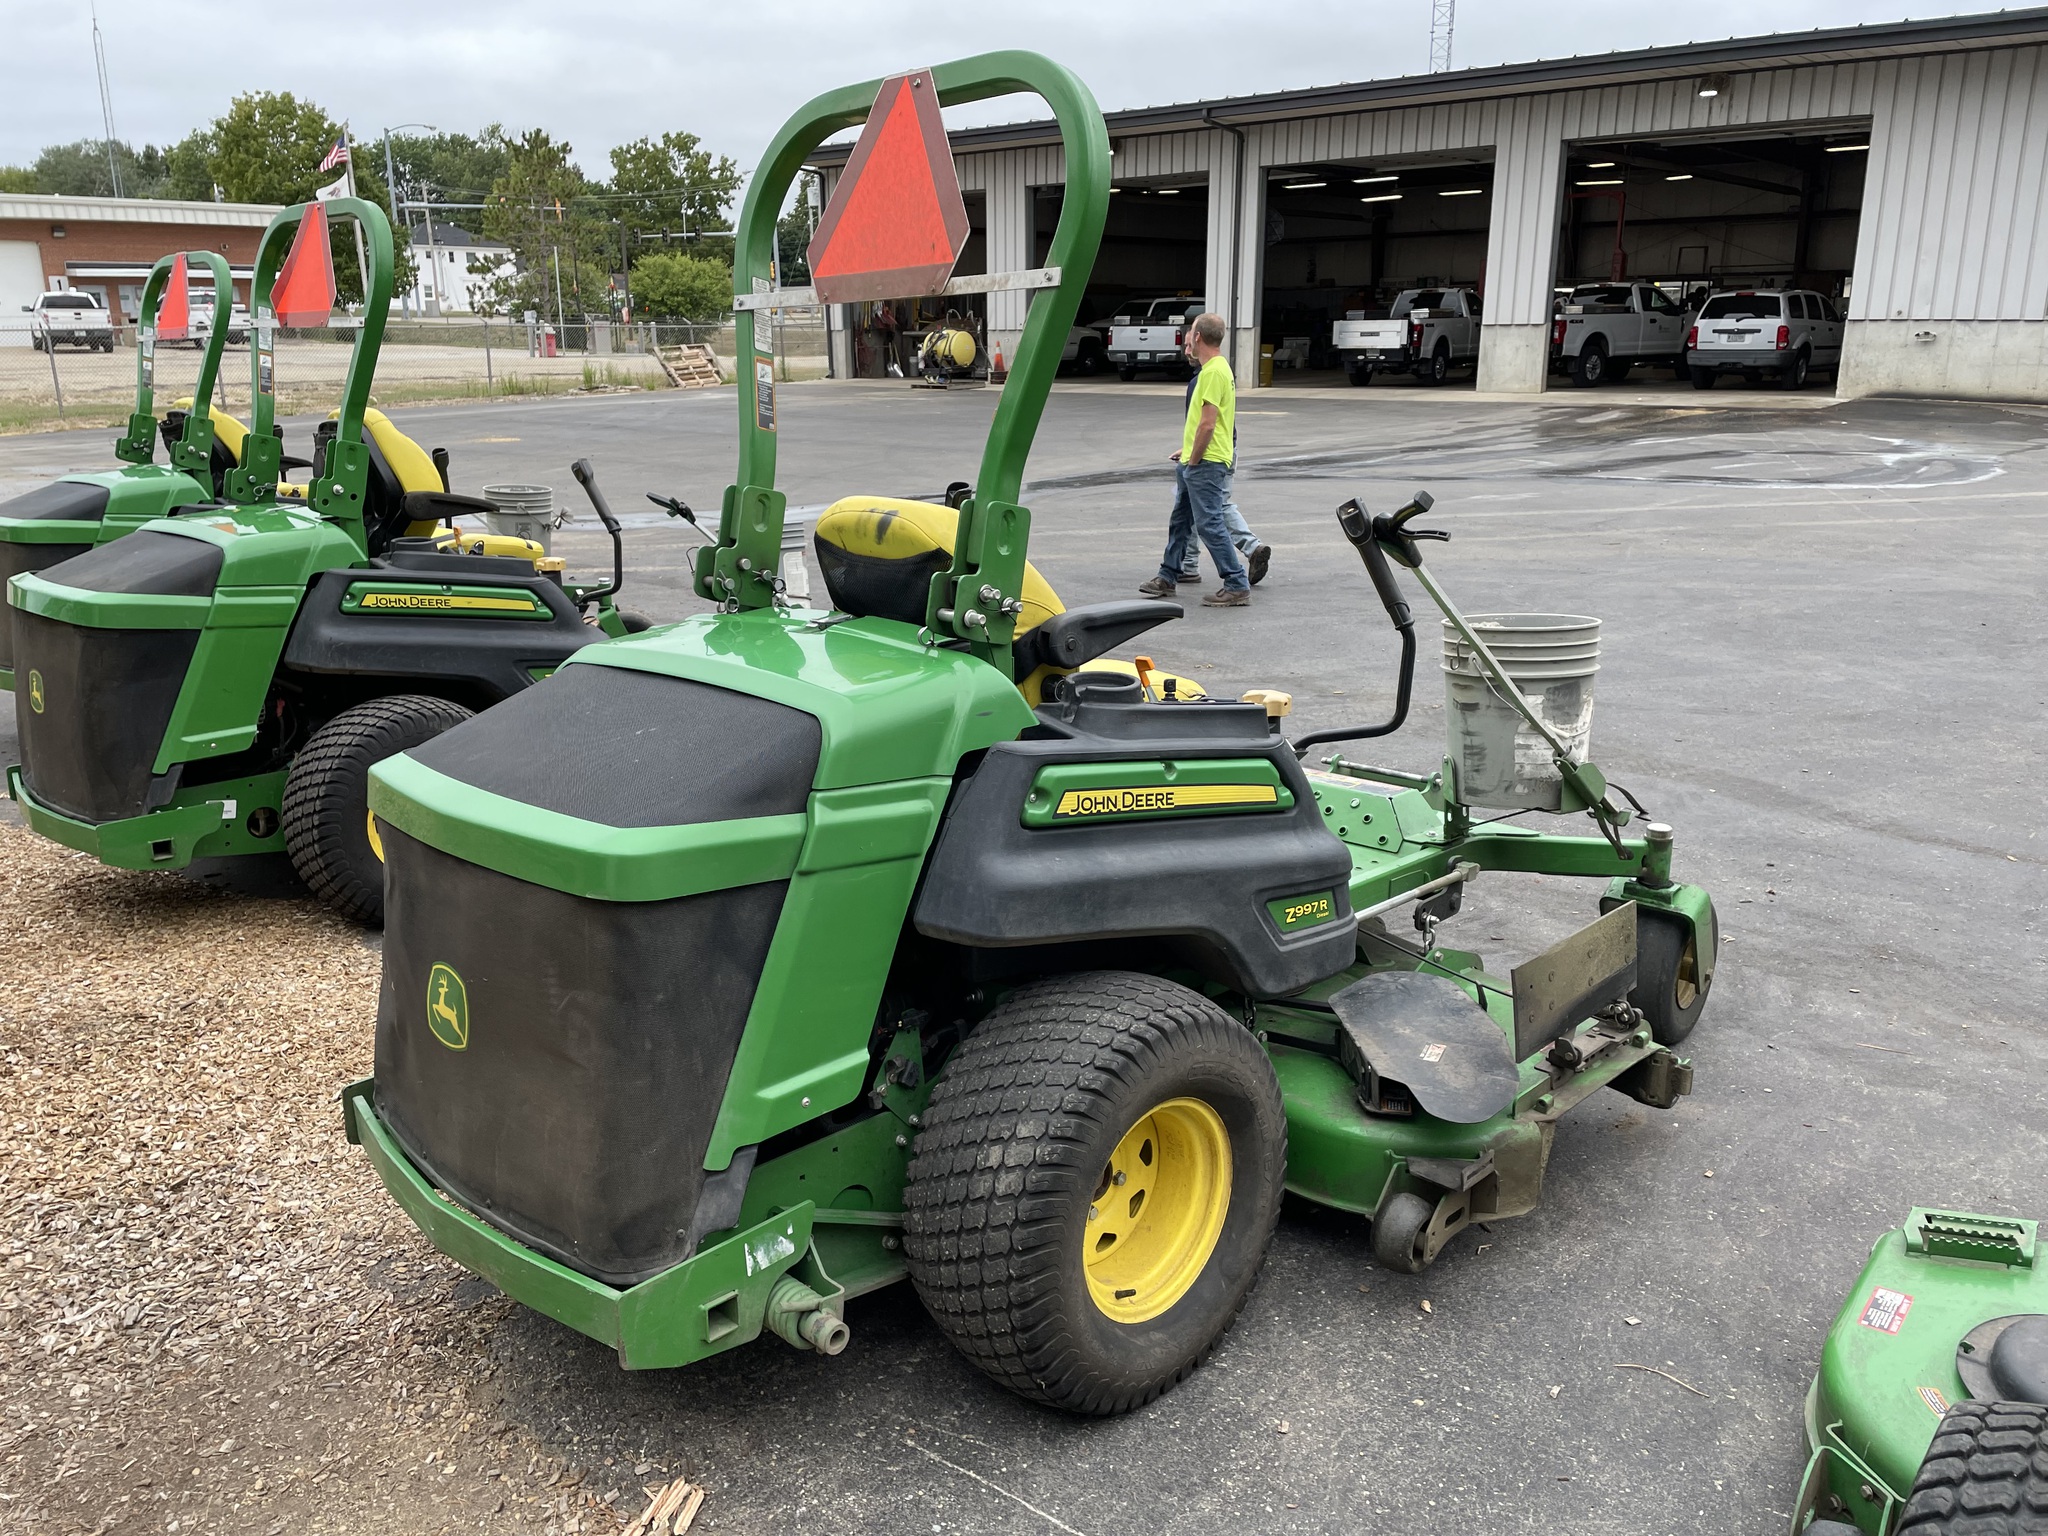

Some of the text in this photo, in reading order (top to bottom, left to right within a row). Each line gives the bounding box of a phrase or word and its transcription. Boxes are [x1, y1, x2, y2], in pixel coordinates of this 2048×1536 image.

[371, 595, 451, 607] JOHN DEERE
[1070, 791, 1175, 814] JOHN DEERE
[1284, 899, 1328, 924] Z997R
